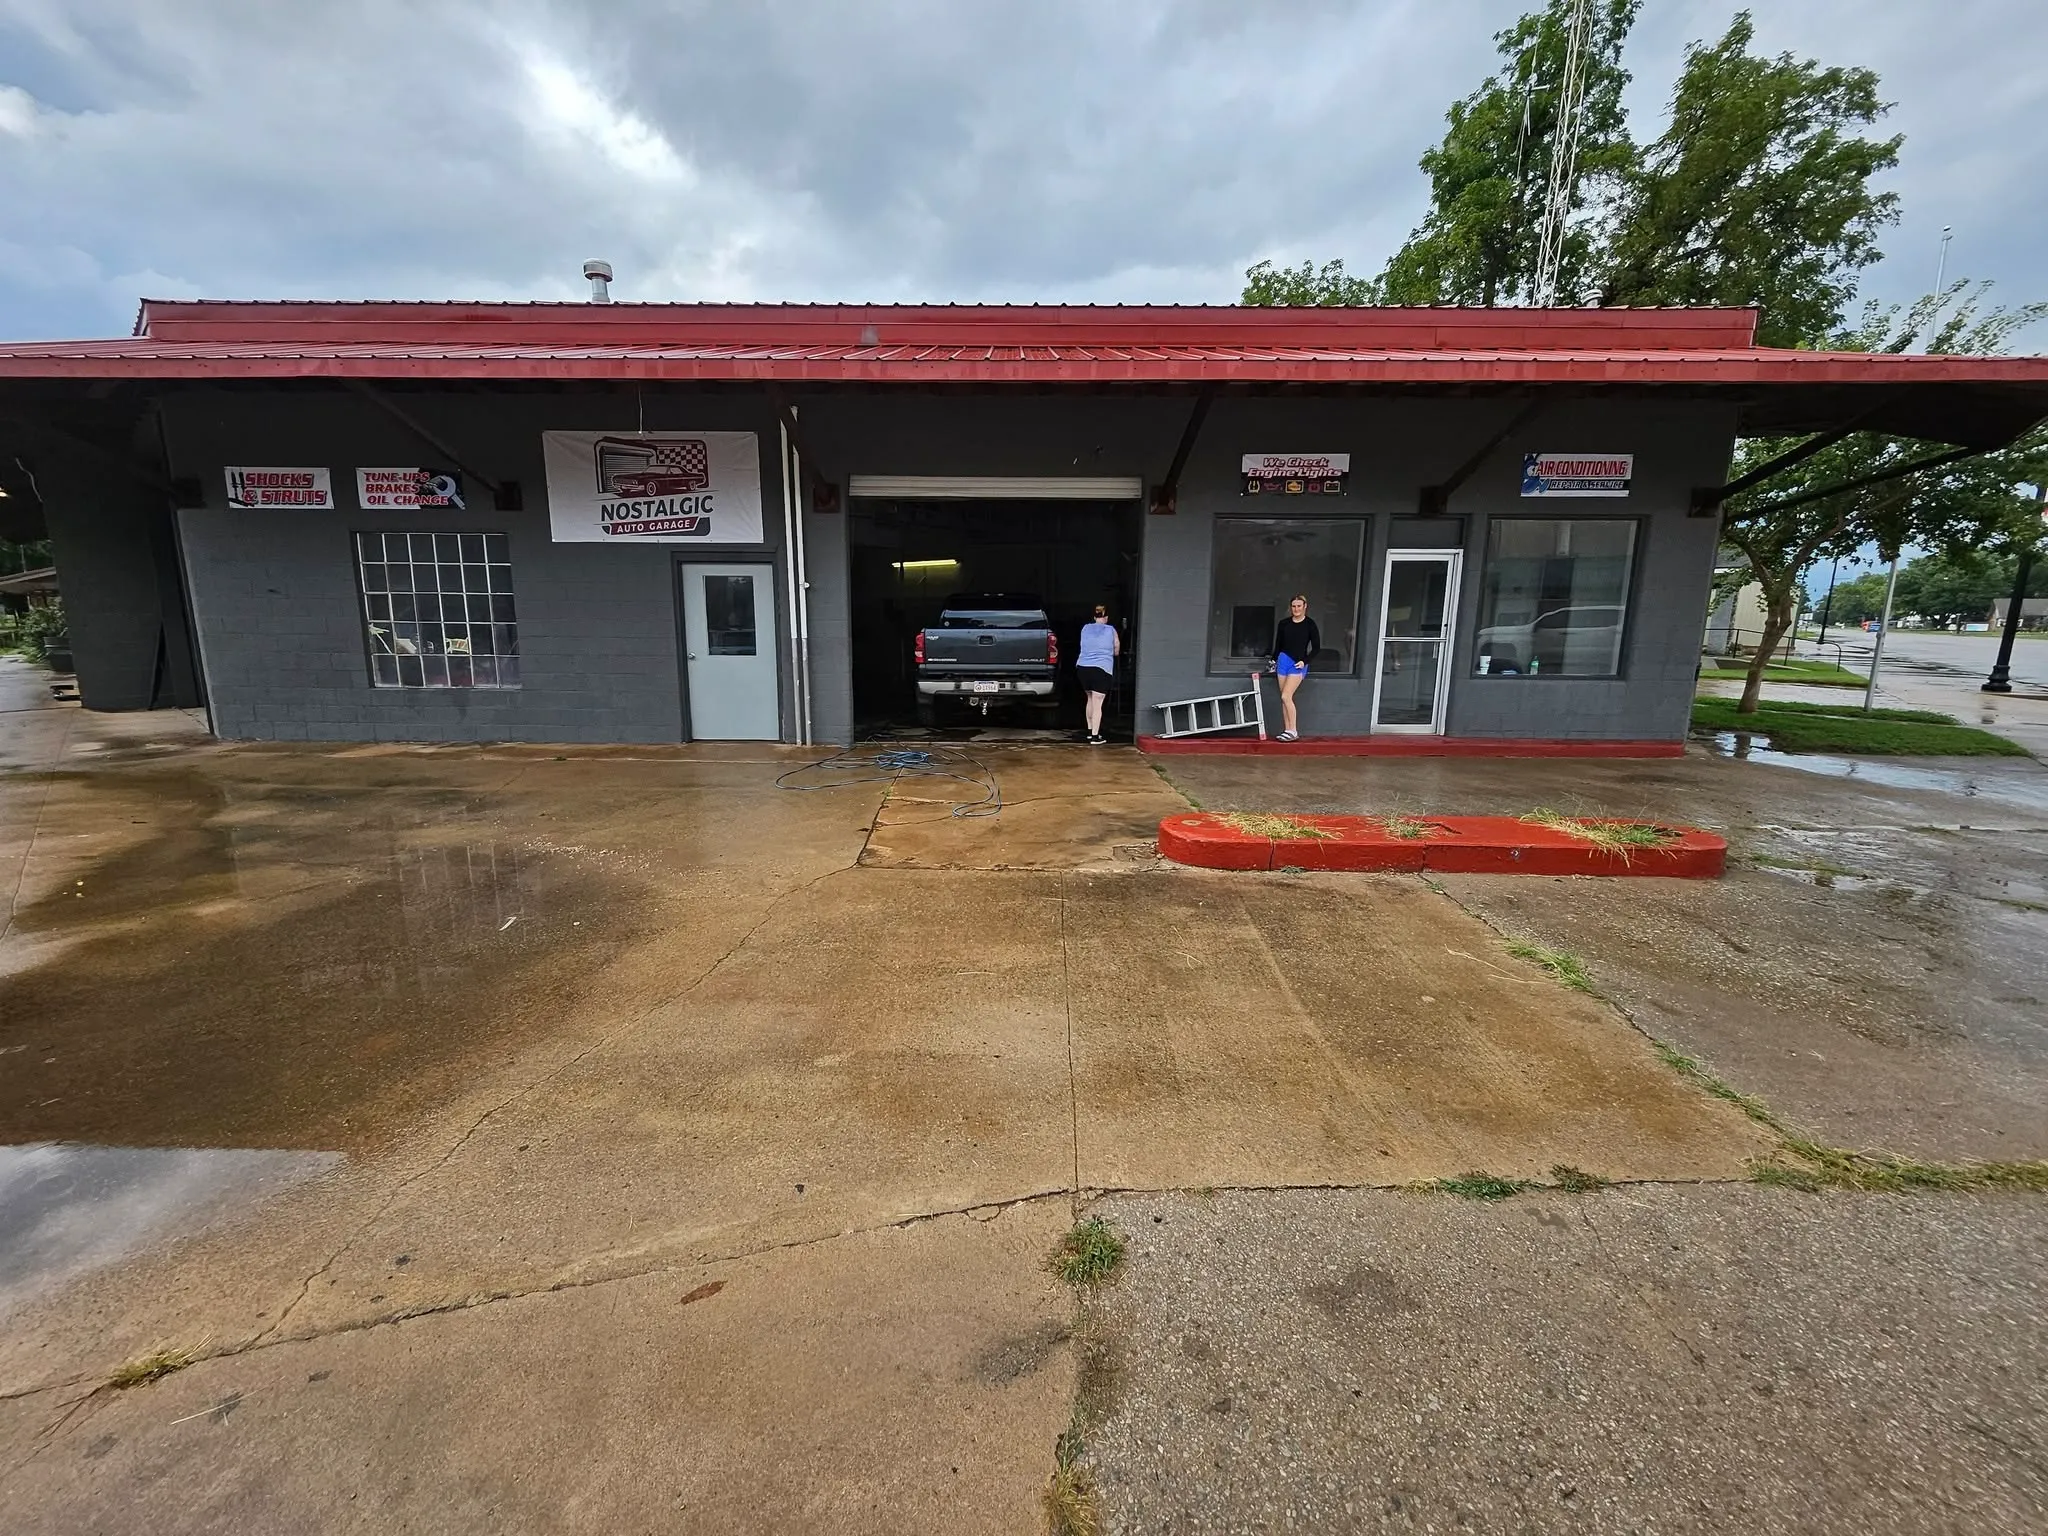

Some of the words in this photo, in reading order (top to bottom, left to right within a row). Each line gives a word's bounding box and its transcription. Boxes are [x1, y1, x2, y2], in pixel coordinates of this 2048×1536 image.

[1263, 457, 1285, 468] We
[1287, 457, 1329, 468] Check
[1247, 468, 1296, 479] Engine
[1297, 467, 1342, 479] Lights
[1537, 461, 1555, 477] AIR
[1556, 461, 1627, 477] CONDITIONING
[245, 473, 314, 488] SHOCKS
[364, 472, 430, 482] TUNE-UPS
[365, 483, 420, 494] BRAKES
[1550, 480, 1581, 489] REPAIR
[243, 488, 258, 504] &
[260, 490, 327, 505] STRUTS
[367, 495, 389, 505] OIL
[393, 495, 449, 505] CHANGE
[601, 495, 714, 521] NOSTALGIC
[617, 522, 645, 533] AUTO
[649, 519, 691, 531] GARAGE
